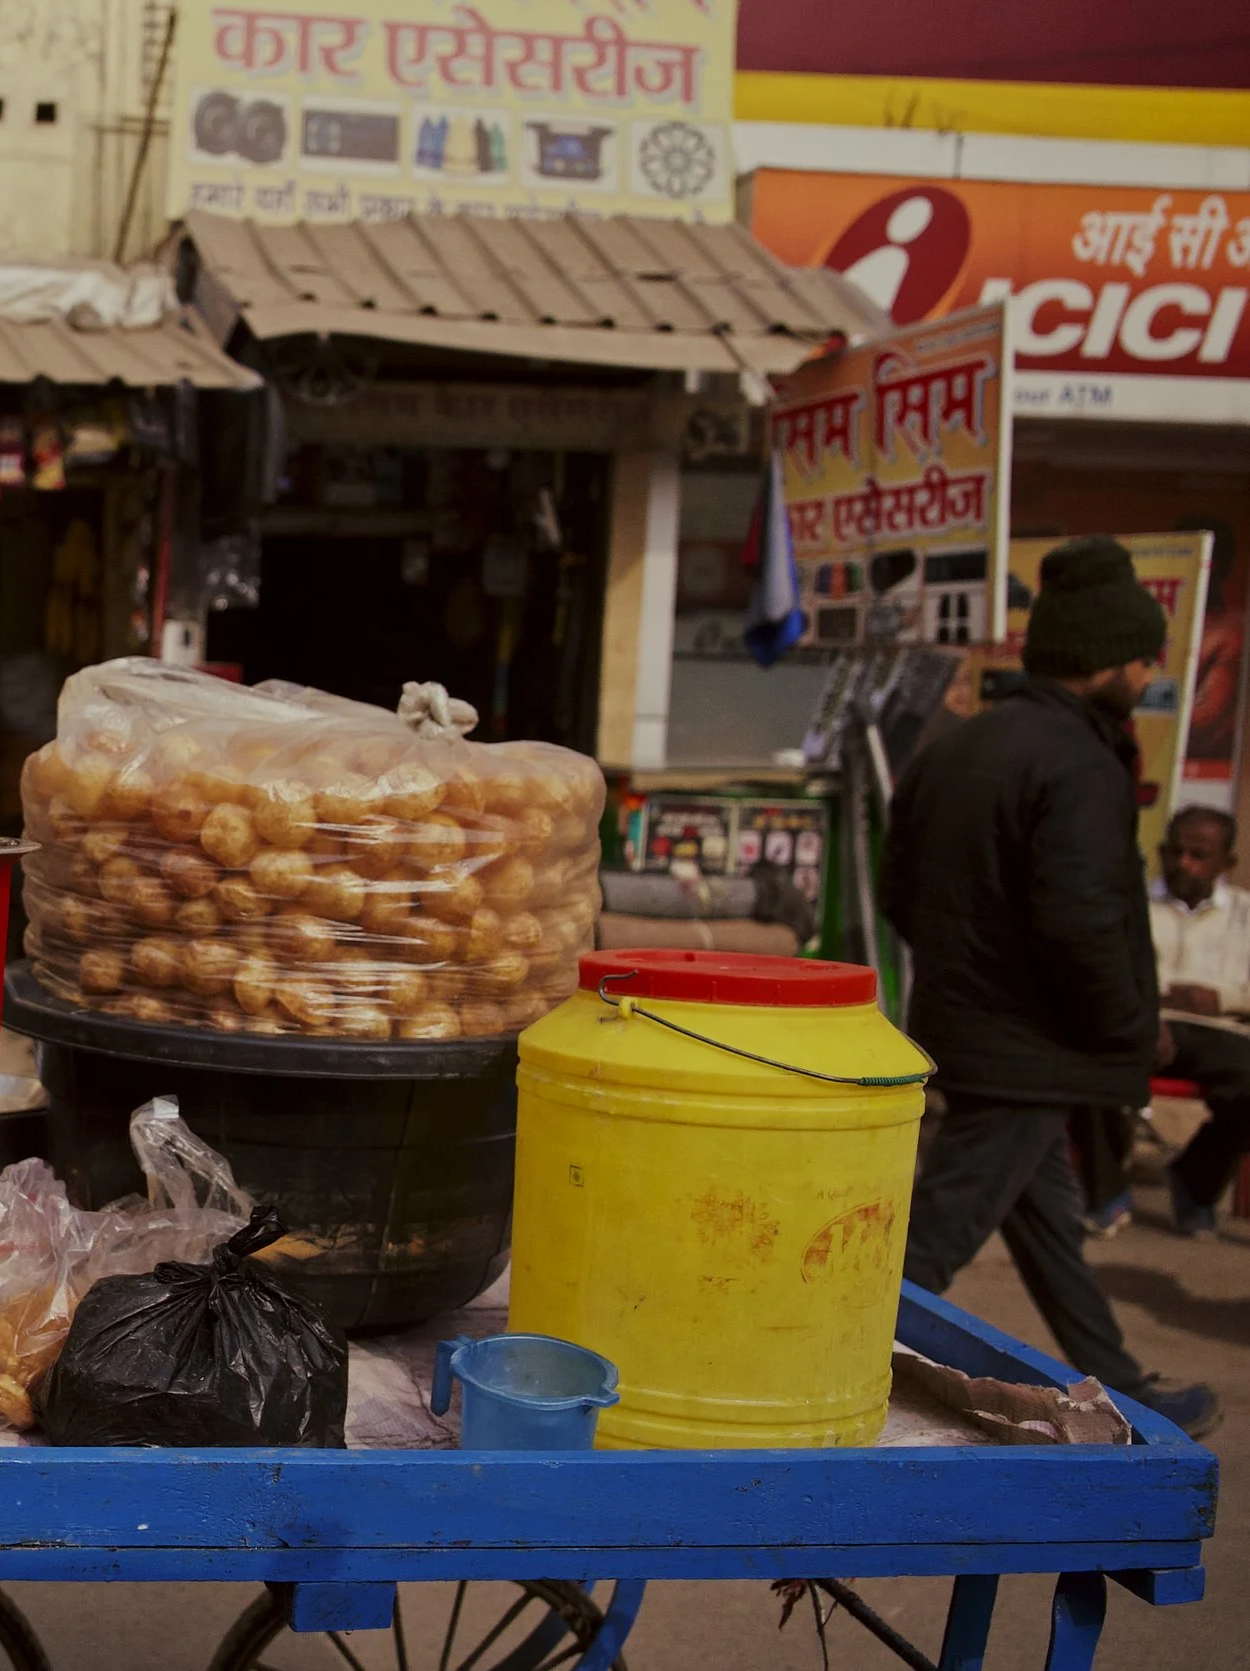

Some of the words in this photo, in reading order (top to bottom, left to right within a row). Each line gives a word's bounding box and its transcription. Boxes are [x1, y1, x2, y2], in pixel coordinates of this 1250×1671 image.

[211, 8, 367, 79] कार
[383, 6, 703, 104] एसेसरीज
[1071, 193, 1174, 279] आई
[1168, 194, 1231, 270] सी
[874, 350, 992, 459] सिम
[1059, 384, 1114, 408] ATM
